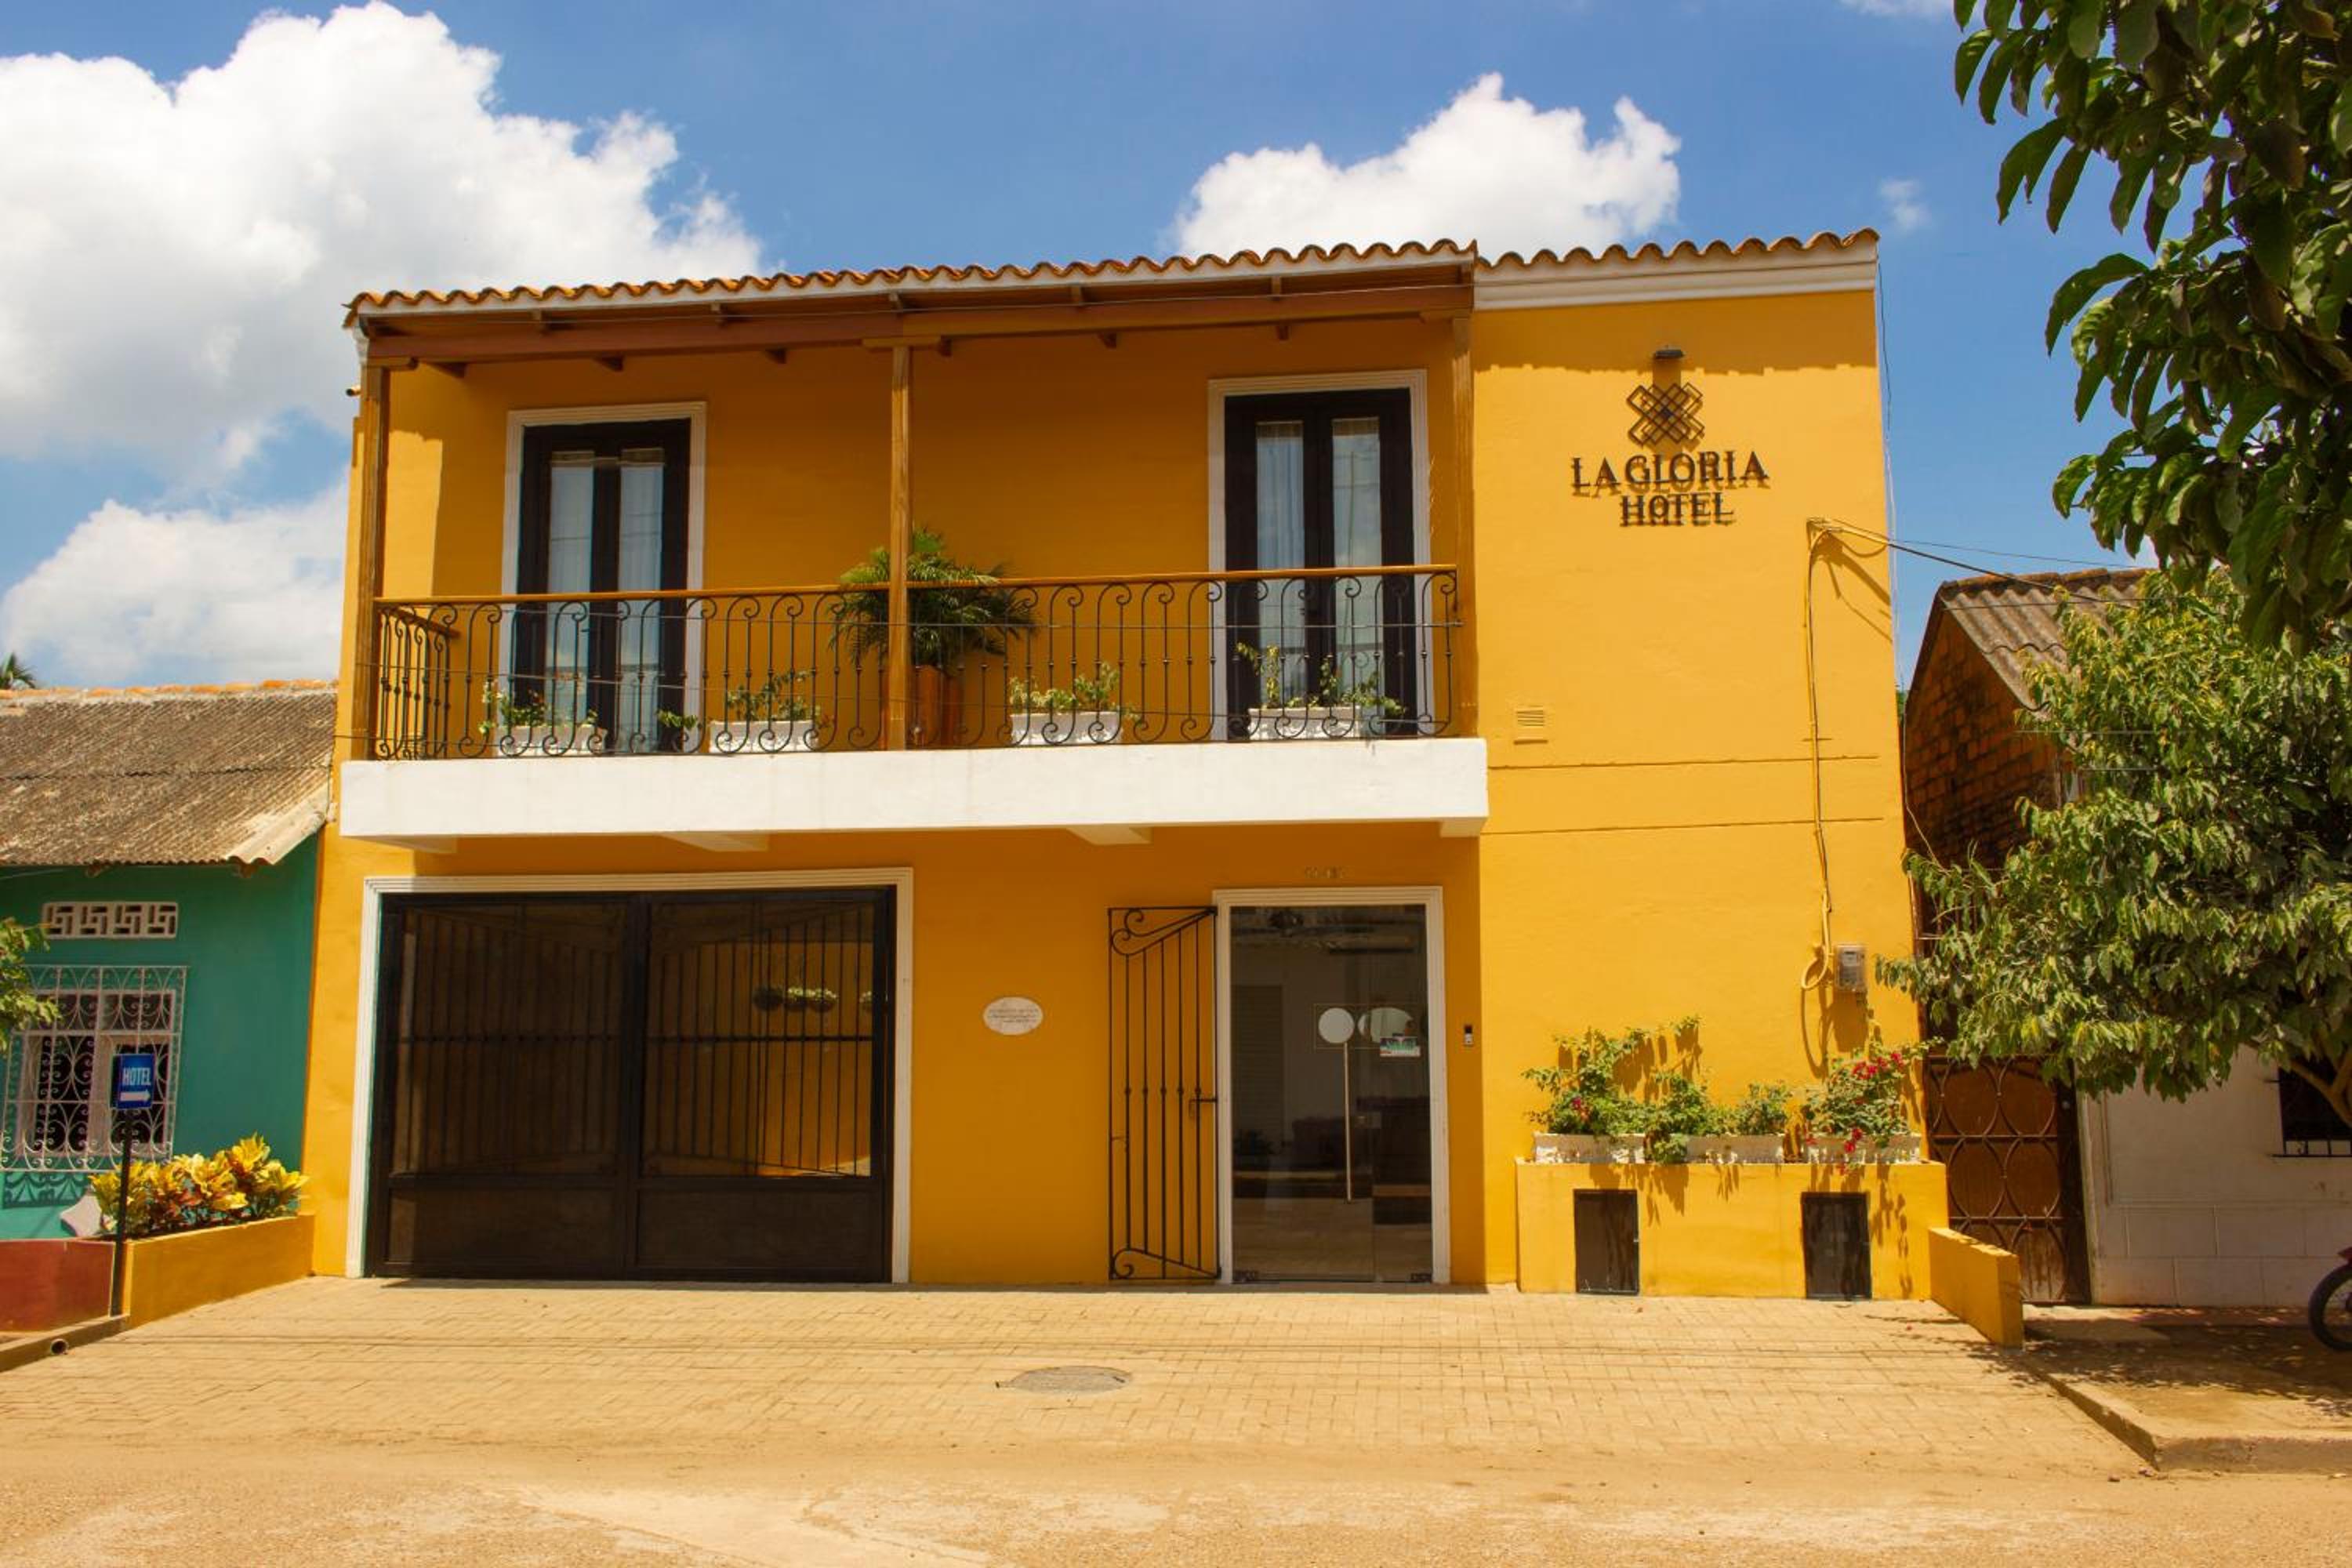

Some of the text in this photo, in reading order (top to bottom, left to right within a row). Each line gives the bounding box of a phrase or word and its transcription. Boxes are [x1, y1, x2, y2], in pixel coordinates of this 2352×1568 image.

[1571, 450, 1769, 488] LA GLORIA
[1620, 492, 1735, 521] HOTEL
[122, 1066, 151, 1087] HOTEL
